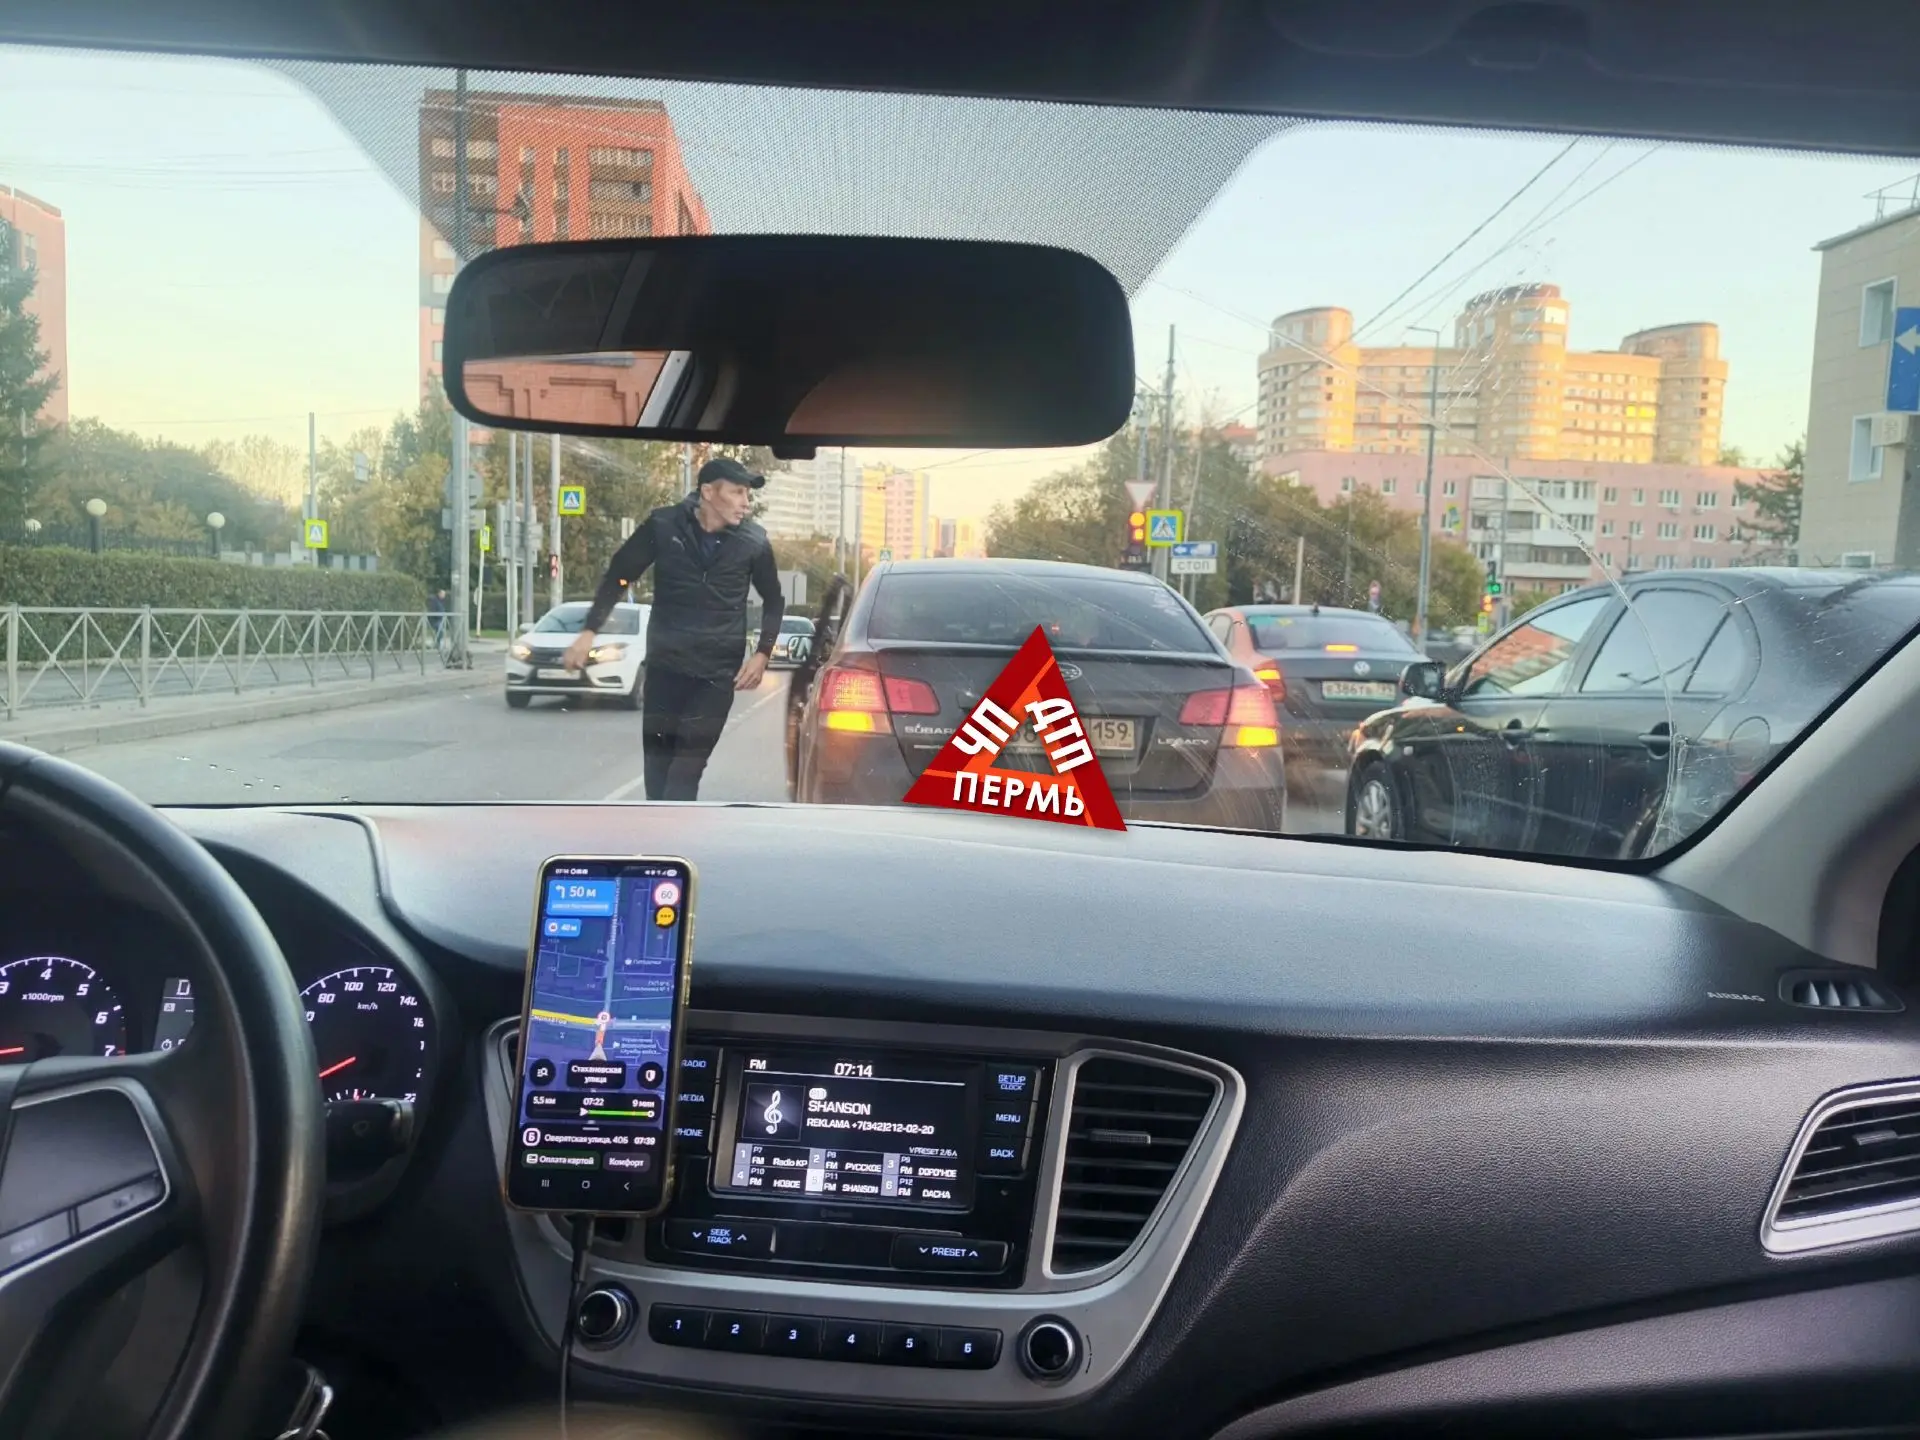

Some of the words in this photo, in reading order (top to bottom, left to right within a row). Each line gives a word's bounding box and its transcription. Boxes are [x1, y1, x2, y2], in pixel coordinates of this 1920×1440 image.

[904, 724, 957, 735] SUBAR
[1092, 721, 1129, 741] 159
[1157, 736, 1209, 746] LEGACY
[569, 886, 585, 898] 50
[660, 890, 673, 900] 60
[40, 968, 52, 980] 4
[76, 983, 90, 996] 5
[343, 981, 364, 992] 100
[377, 982, 397, 992] 120
[22, 993, 65, 1002] x1000rpm
[317, 993, 336, 1003] 80
[1706, 991, 1766, 1002] AIRBAG
[356, 1002, 379, 1010] km/h
[95, 1011, 108, 1024] 6
[104, 1045, 115, 1057] 7
[681, 1059, 708, 1068] RADIO
[749, 1059, 767, 1070] FM
[571, 1065, 623, 1074] Стахановская
[833, 1062, 873, 1077] 07:14
[584, 1076, 608, 1084] улица
[998, 1074, 1026, 1082] SETUP
[1000, 1083, 1023, 1091] CLOCK
[582, 1098, 605, 1107] 07:22
[632, 1099, 638, 1107] 9
[678, 1094, 705, 1102] MEDIA
[807, 1100, 871, 1115] SHANSON
[806, 1117, 850, 1129] REKLAMA
[995, 1113, 1021, 1123] MENU
[674, 1129, 704, 1137] PHONE
[740, 1149, 746, 1158] 1
[990, 1148, 1015, 1158] BACK
[539, 1154, 567, 1164] Оплата
[568, 1156, 595, 1166] картой
[608, 1157, 644, 1167] Комфорт
[751, 1156, 765, 1165] FM
[772, 1157, 796, 1167] Radio
[813, 1154, 820, 1163] 2
[887, 1159, 894, 1168] 3
[825, 1161, 839, 1170] FM
[900, 1166, 913, 1175] FM
[737, 1171, 744, 1179] 4
[750, 1167, 765, 1175] P10
[824, 1172, 839, 1180] P11
[749, 1177, 762, 1186] FM
[885, 1181, 893, 1190] 6
[899, 1178, 914, 1186] P12
[823, 1183, 837, 1191] FM
[841, 1184, 879, 1194] SHANSON
[898, 1187, 912, 1196] FM
[921, 1188, 951, 1199] DACHA
[710, 1228, 731, 1237] SEEK
[707, 1236, 732, 1244] TRACK
[931, 1246, 967, 1258] PRESET
[674, 1319, 682, 1330] 1
[731, 1323, 740, 1334] 2
[788, 1329, 797, 1340] 3
[847, 1334, 856, 1344] 4
[905, 1338, 914, 1349] 5
[963, 1343, 972, 1353] 6
